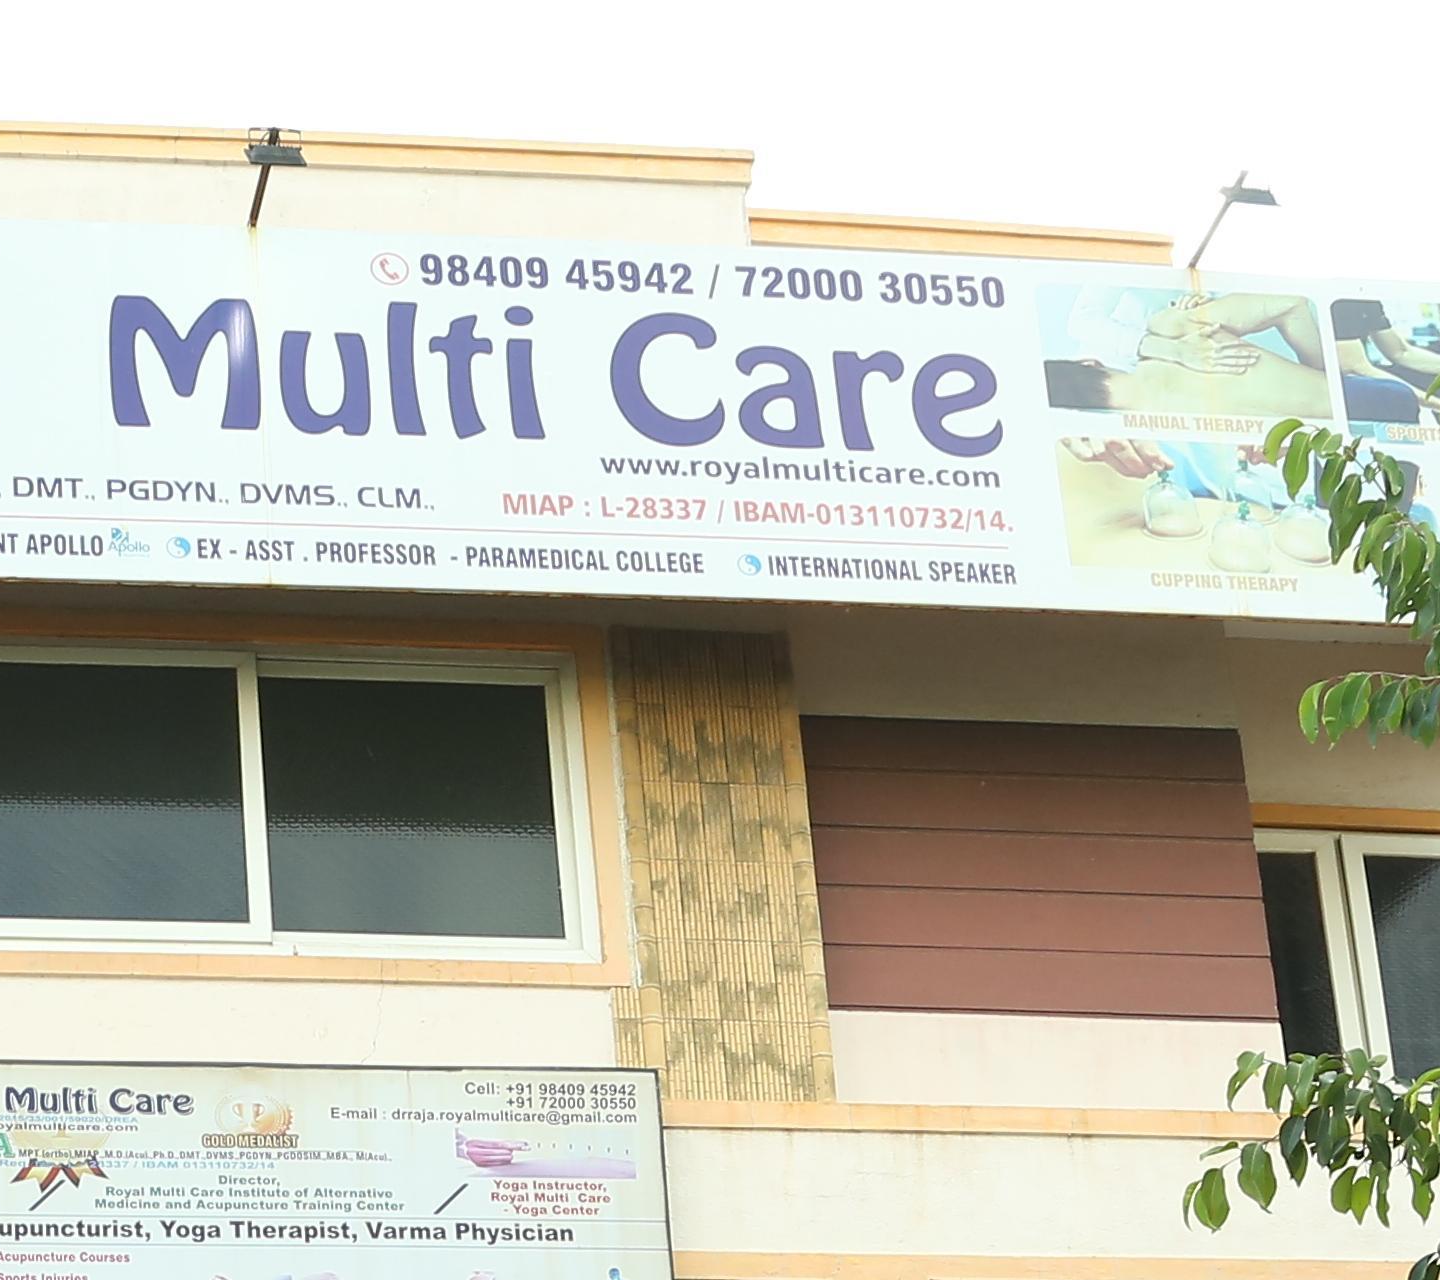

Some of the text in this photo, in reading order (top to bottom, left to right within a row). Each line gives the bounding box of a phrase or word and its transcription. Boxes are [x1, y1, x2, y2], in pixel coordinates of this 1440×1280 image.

[420, 253, 1005, 308] 98409 45942 72000 30550
[109, 294, 546, 440] Multi
[610, 312, 1003, 457] Care
[1123, 414, 1264, 434] MANUAL THERAPY
[600, 455, 1001, 489] www.royalmulticare.com
[502, 492, 574, 517] MIAP
[601, 496, 707, 522] L-28337
[26, 534, 103, 557] APOLLO
[197, 538, 704, 575] EX ASST PROFESSOR PARAMEDICAL COLLEGE
[768, 555, 1017, 586] INTERNATIONAL SPEAKER
[1151, 573, 1298, 593] CUPPING THERAPY
[5, 1086, 98, 1114] Multi
[110, 1088, 194, 1115] Care
[465, 1082, 636, 1096] Cell: +91 98409 45942
[331, 1107, 377, 1120] E-mail
[506, 1097, 636, 1109] +91 72000 30550
[202, 1134, 299, 1148] GOLD MEDALIST
[160, 1220, 221, 1242] Yoga
[230, 1220, 358, 1243] Therapist,
[366, 1222, 447, 1241] Varma
[455, 1222, 574, 1245] Physician
